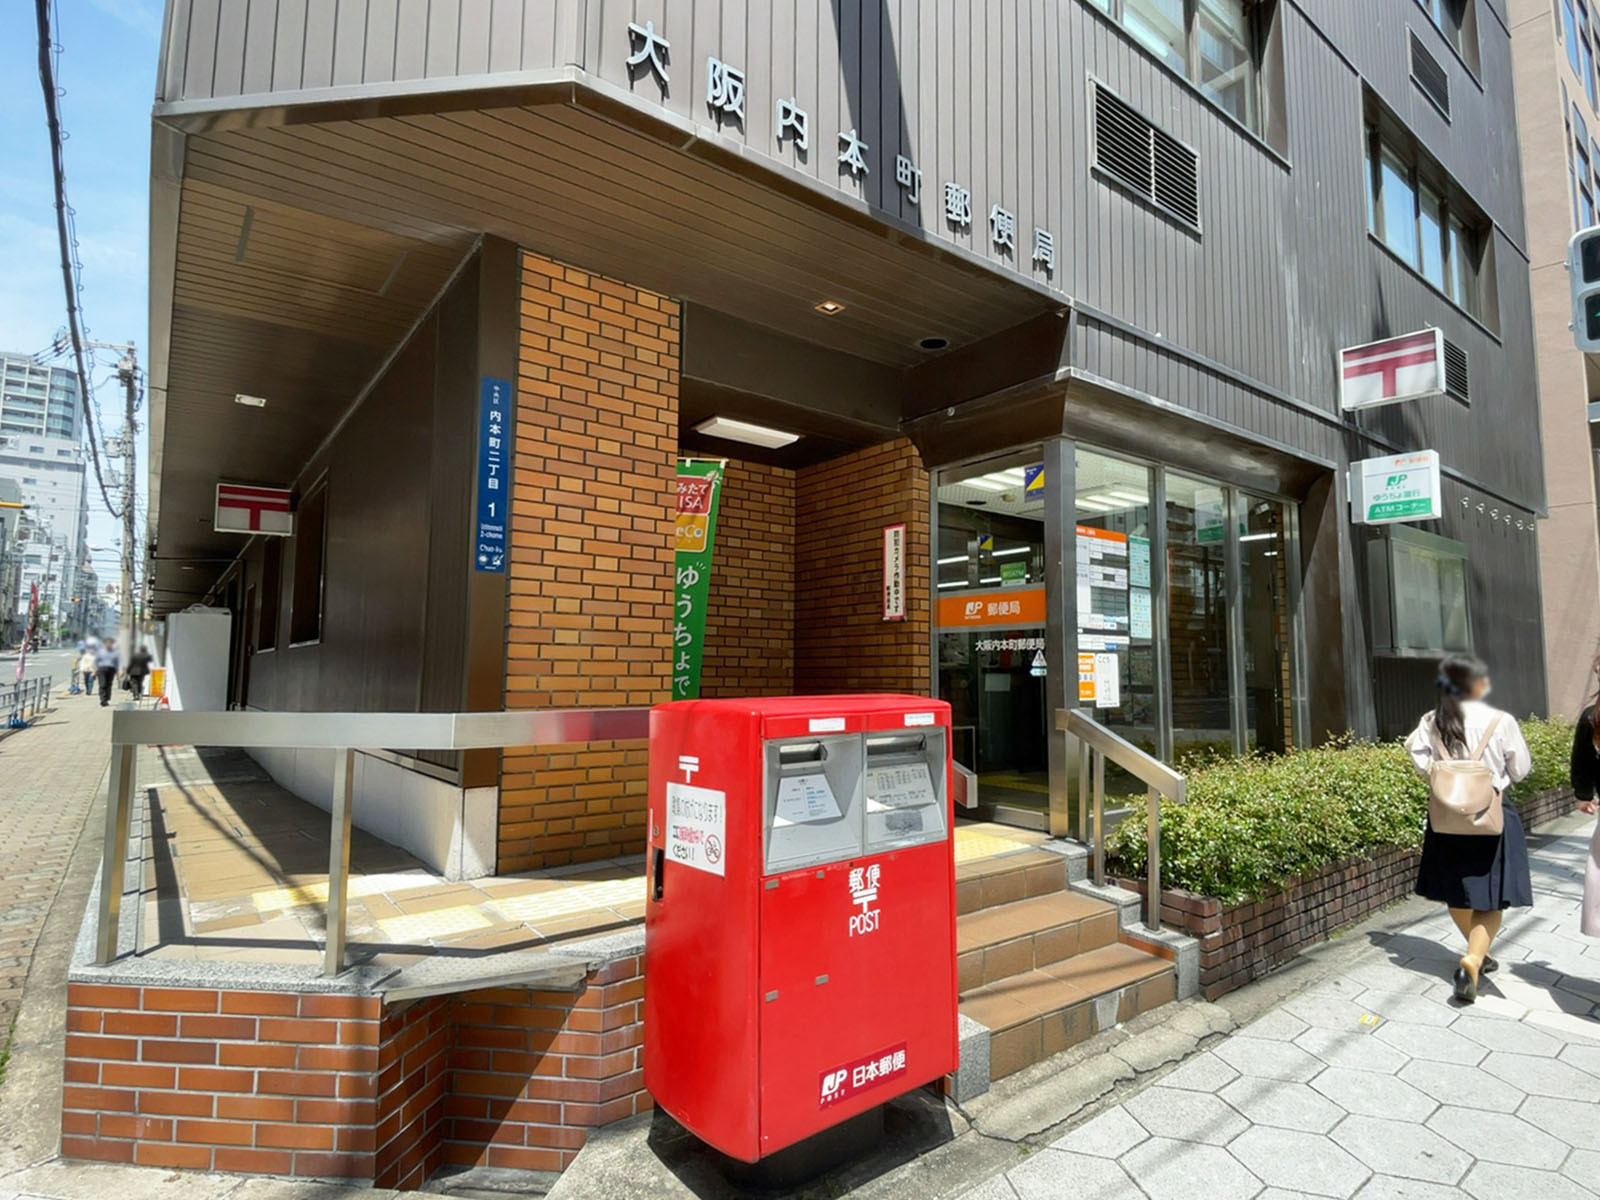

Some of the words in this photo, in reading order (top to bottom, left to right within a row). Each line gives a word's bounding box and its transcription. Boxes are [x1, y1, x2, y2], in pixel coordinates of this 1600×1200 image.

[626, 20, 1056, 269] 大阪内本町郵便局
[488, 410, 502, 490] 内本町二丁目
[488, 502, 496, 517] 1
[987, 601, 1021, 616] 郵便局
[674, 565, 699, 696] ゆうちょで
[975, 637, 1045, 652] 大阪内本町郵便局
[849, 864, 881, 894] 郵便
[849, 909, 881, 937] POST
[853, 1050, 905, 1088] 日本郵便
